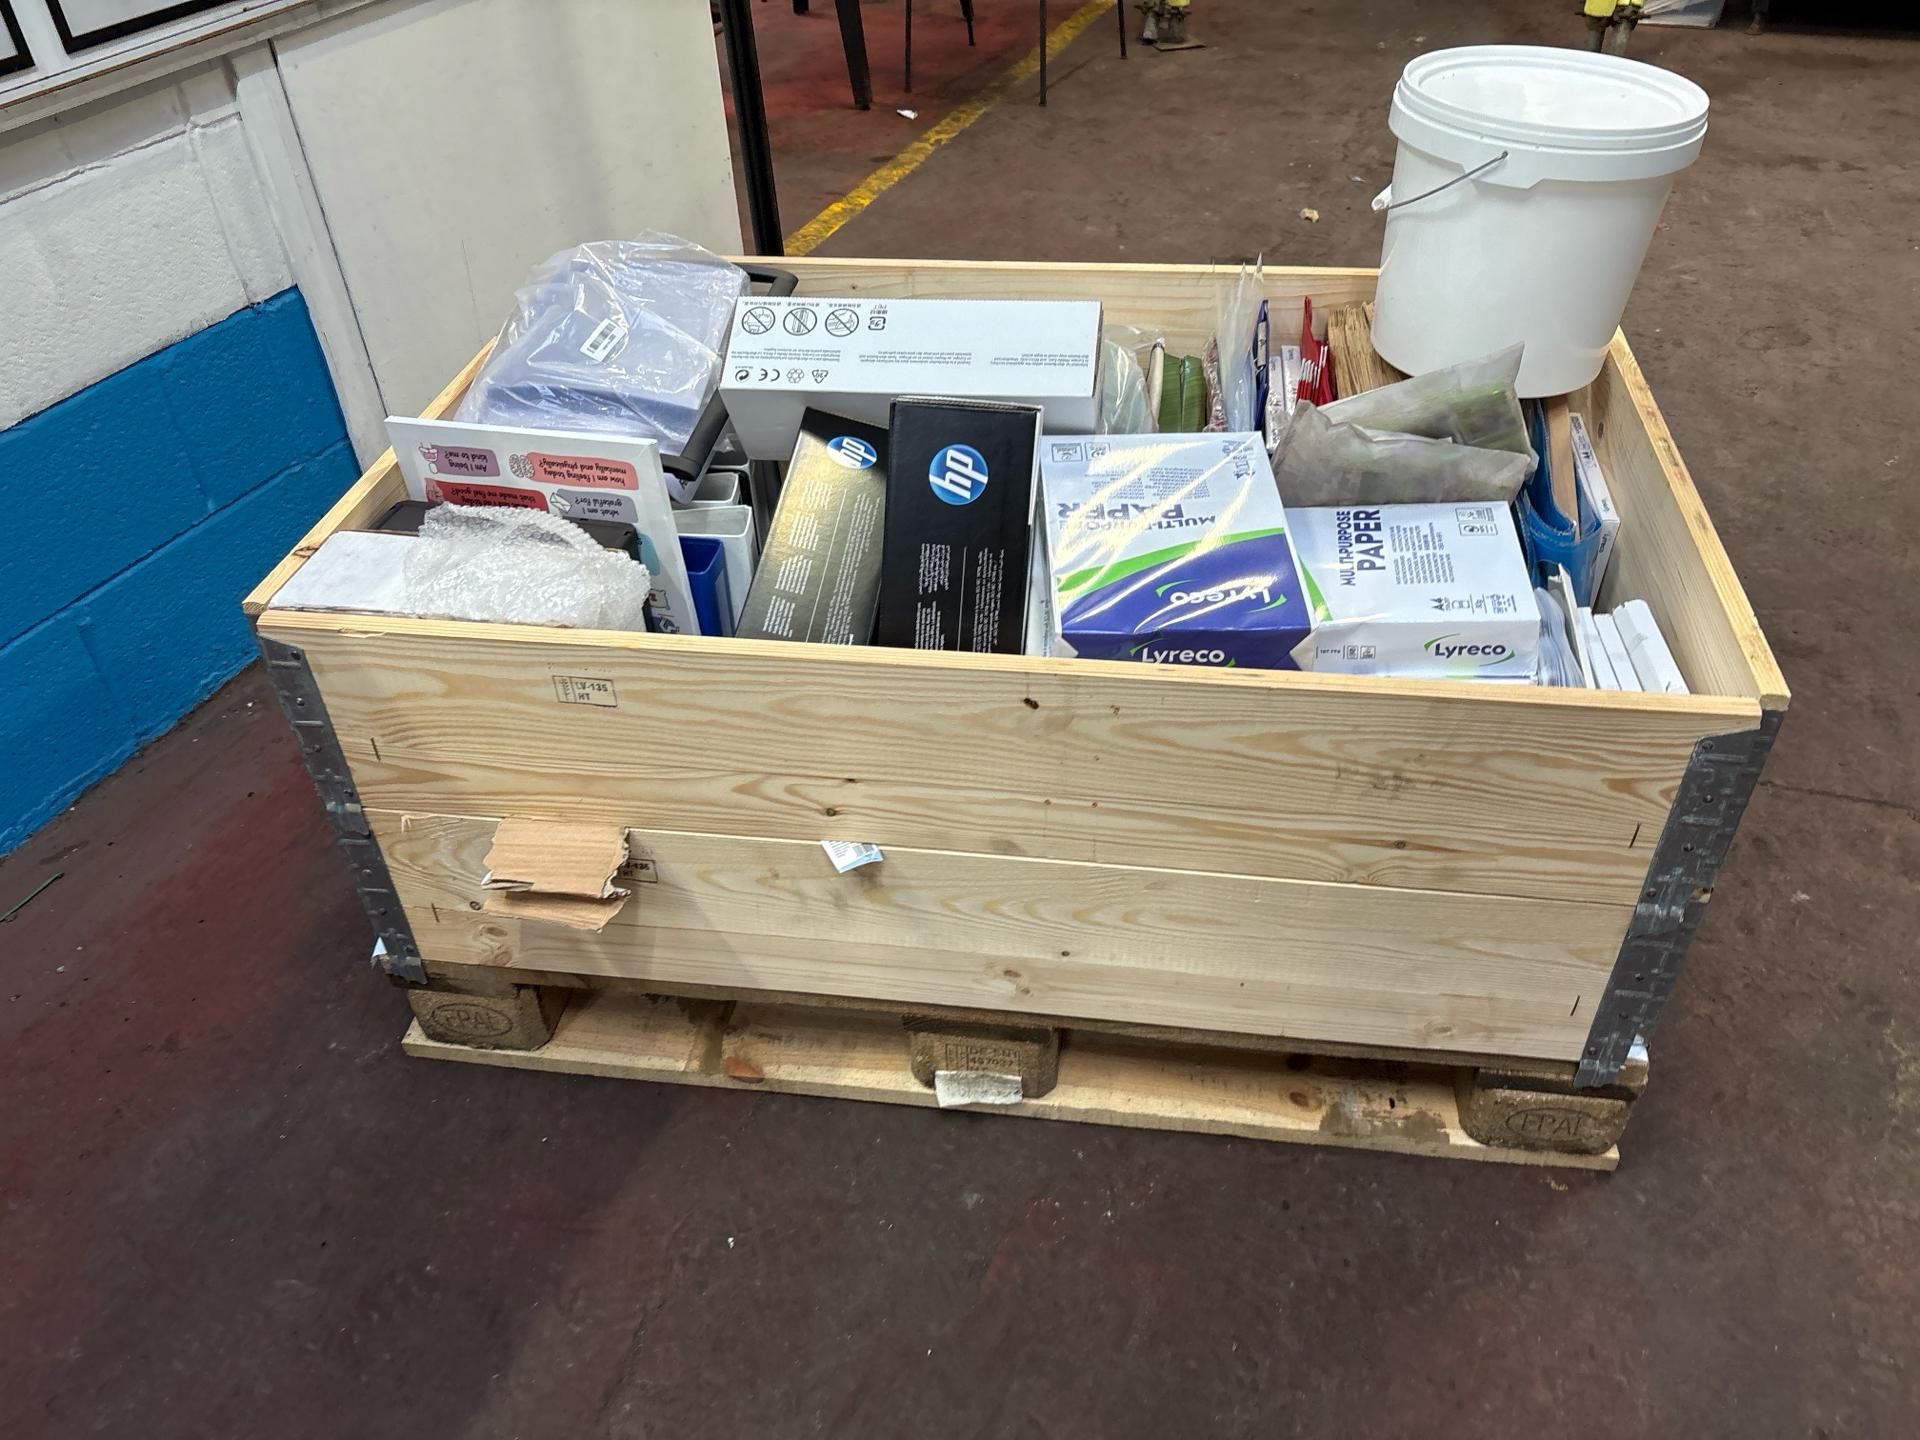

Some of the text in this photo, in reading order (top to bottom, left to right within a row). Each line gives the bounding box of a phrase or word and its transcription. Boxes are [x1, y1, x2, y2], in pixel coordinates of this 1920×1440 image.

[444, 450, 488, 463] kind to me?
[827, 437, 877, 468] hp
[448, 459, 470, 472] being
[475, 463, 487, 472] Am
[539, 458, 627, 474] mentally and physically?
[544, 467, 566, 479] today
[566, 470, 591, 482] feeling
[929, 449, 988, 500] hp
[610, 477, 625, 486] how
[575, 496, 622, 507] grateful for?
[601, 509, 620, 517] what
[1352, 509, 1386, 572] PAPER
[1169, 585, 1271, 604] Lyreco
[1142, 647, 1225, 664] Lyreco
[1434, 642, 1506, 659] Lyreco
